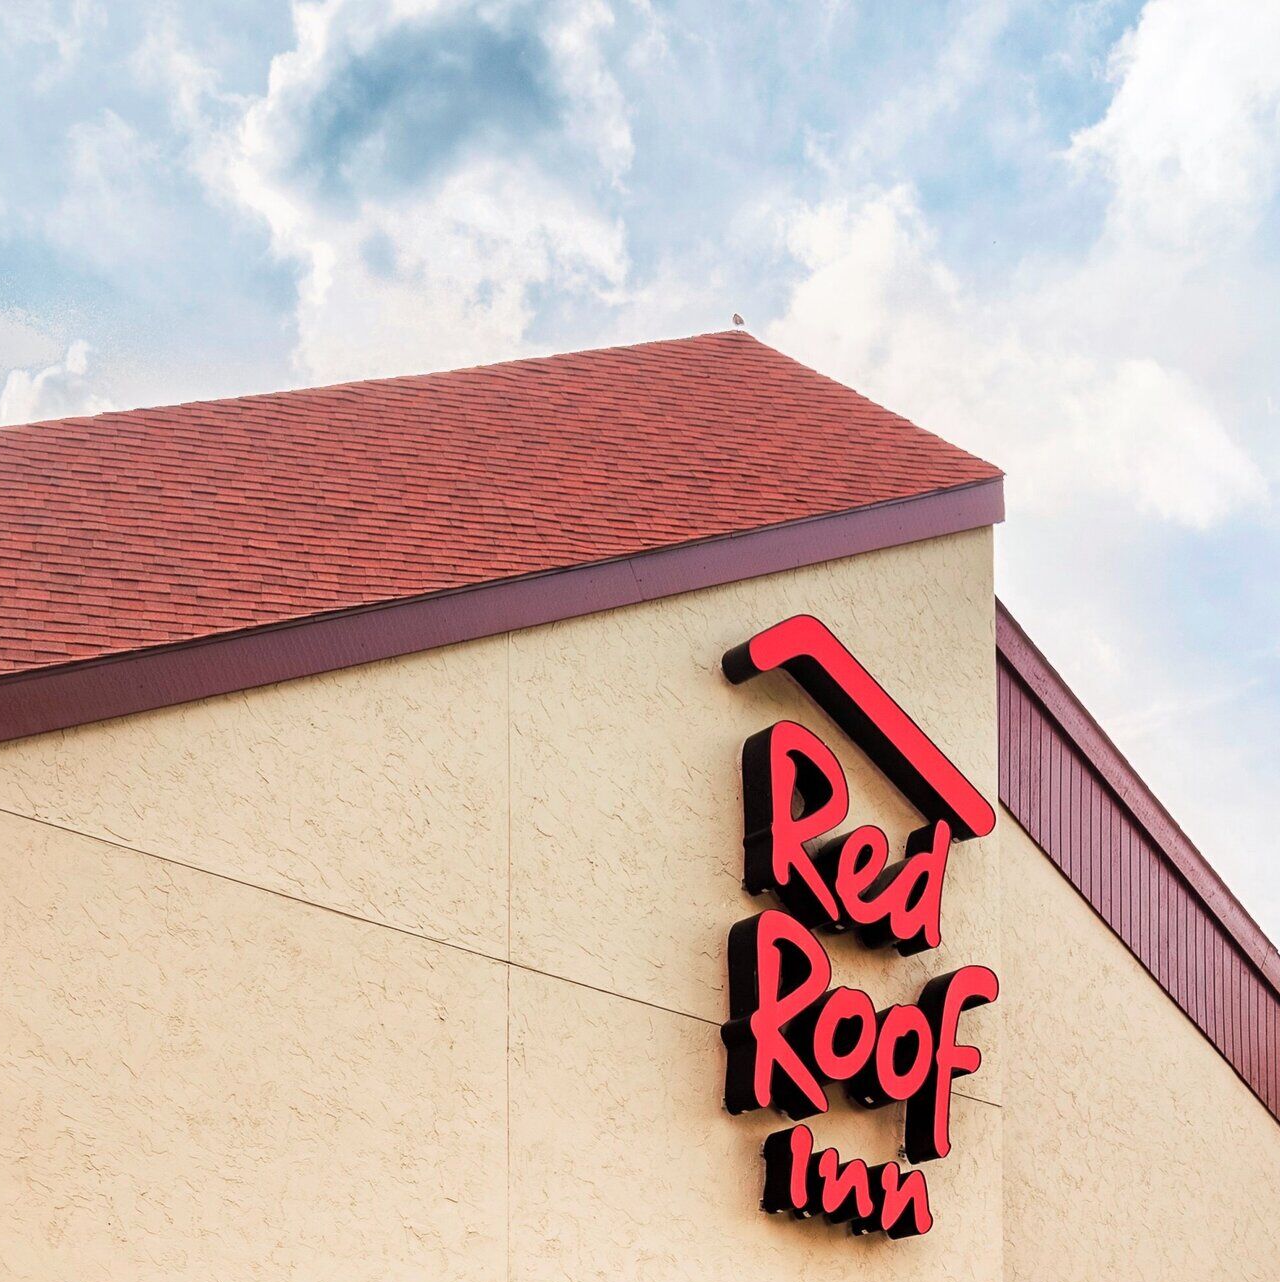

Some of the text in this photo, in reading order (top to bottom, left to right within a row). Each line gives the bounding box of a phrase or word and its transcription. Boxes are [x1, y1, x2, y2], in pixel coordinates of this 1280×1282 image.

[769, 720, 951, 949] Red
[749, 908, 999, 1158] Roof
[789, 1124, 933, 1235] Inn
